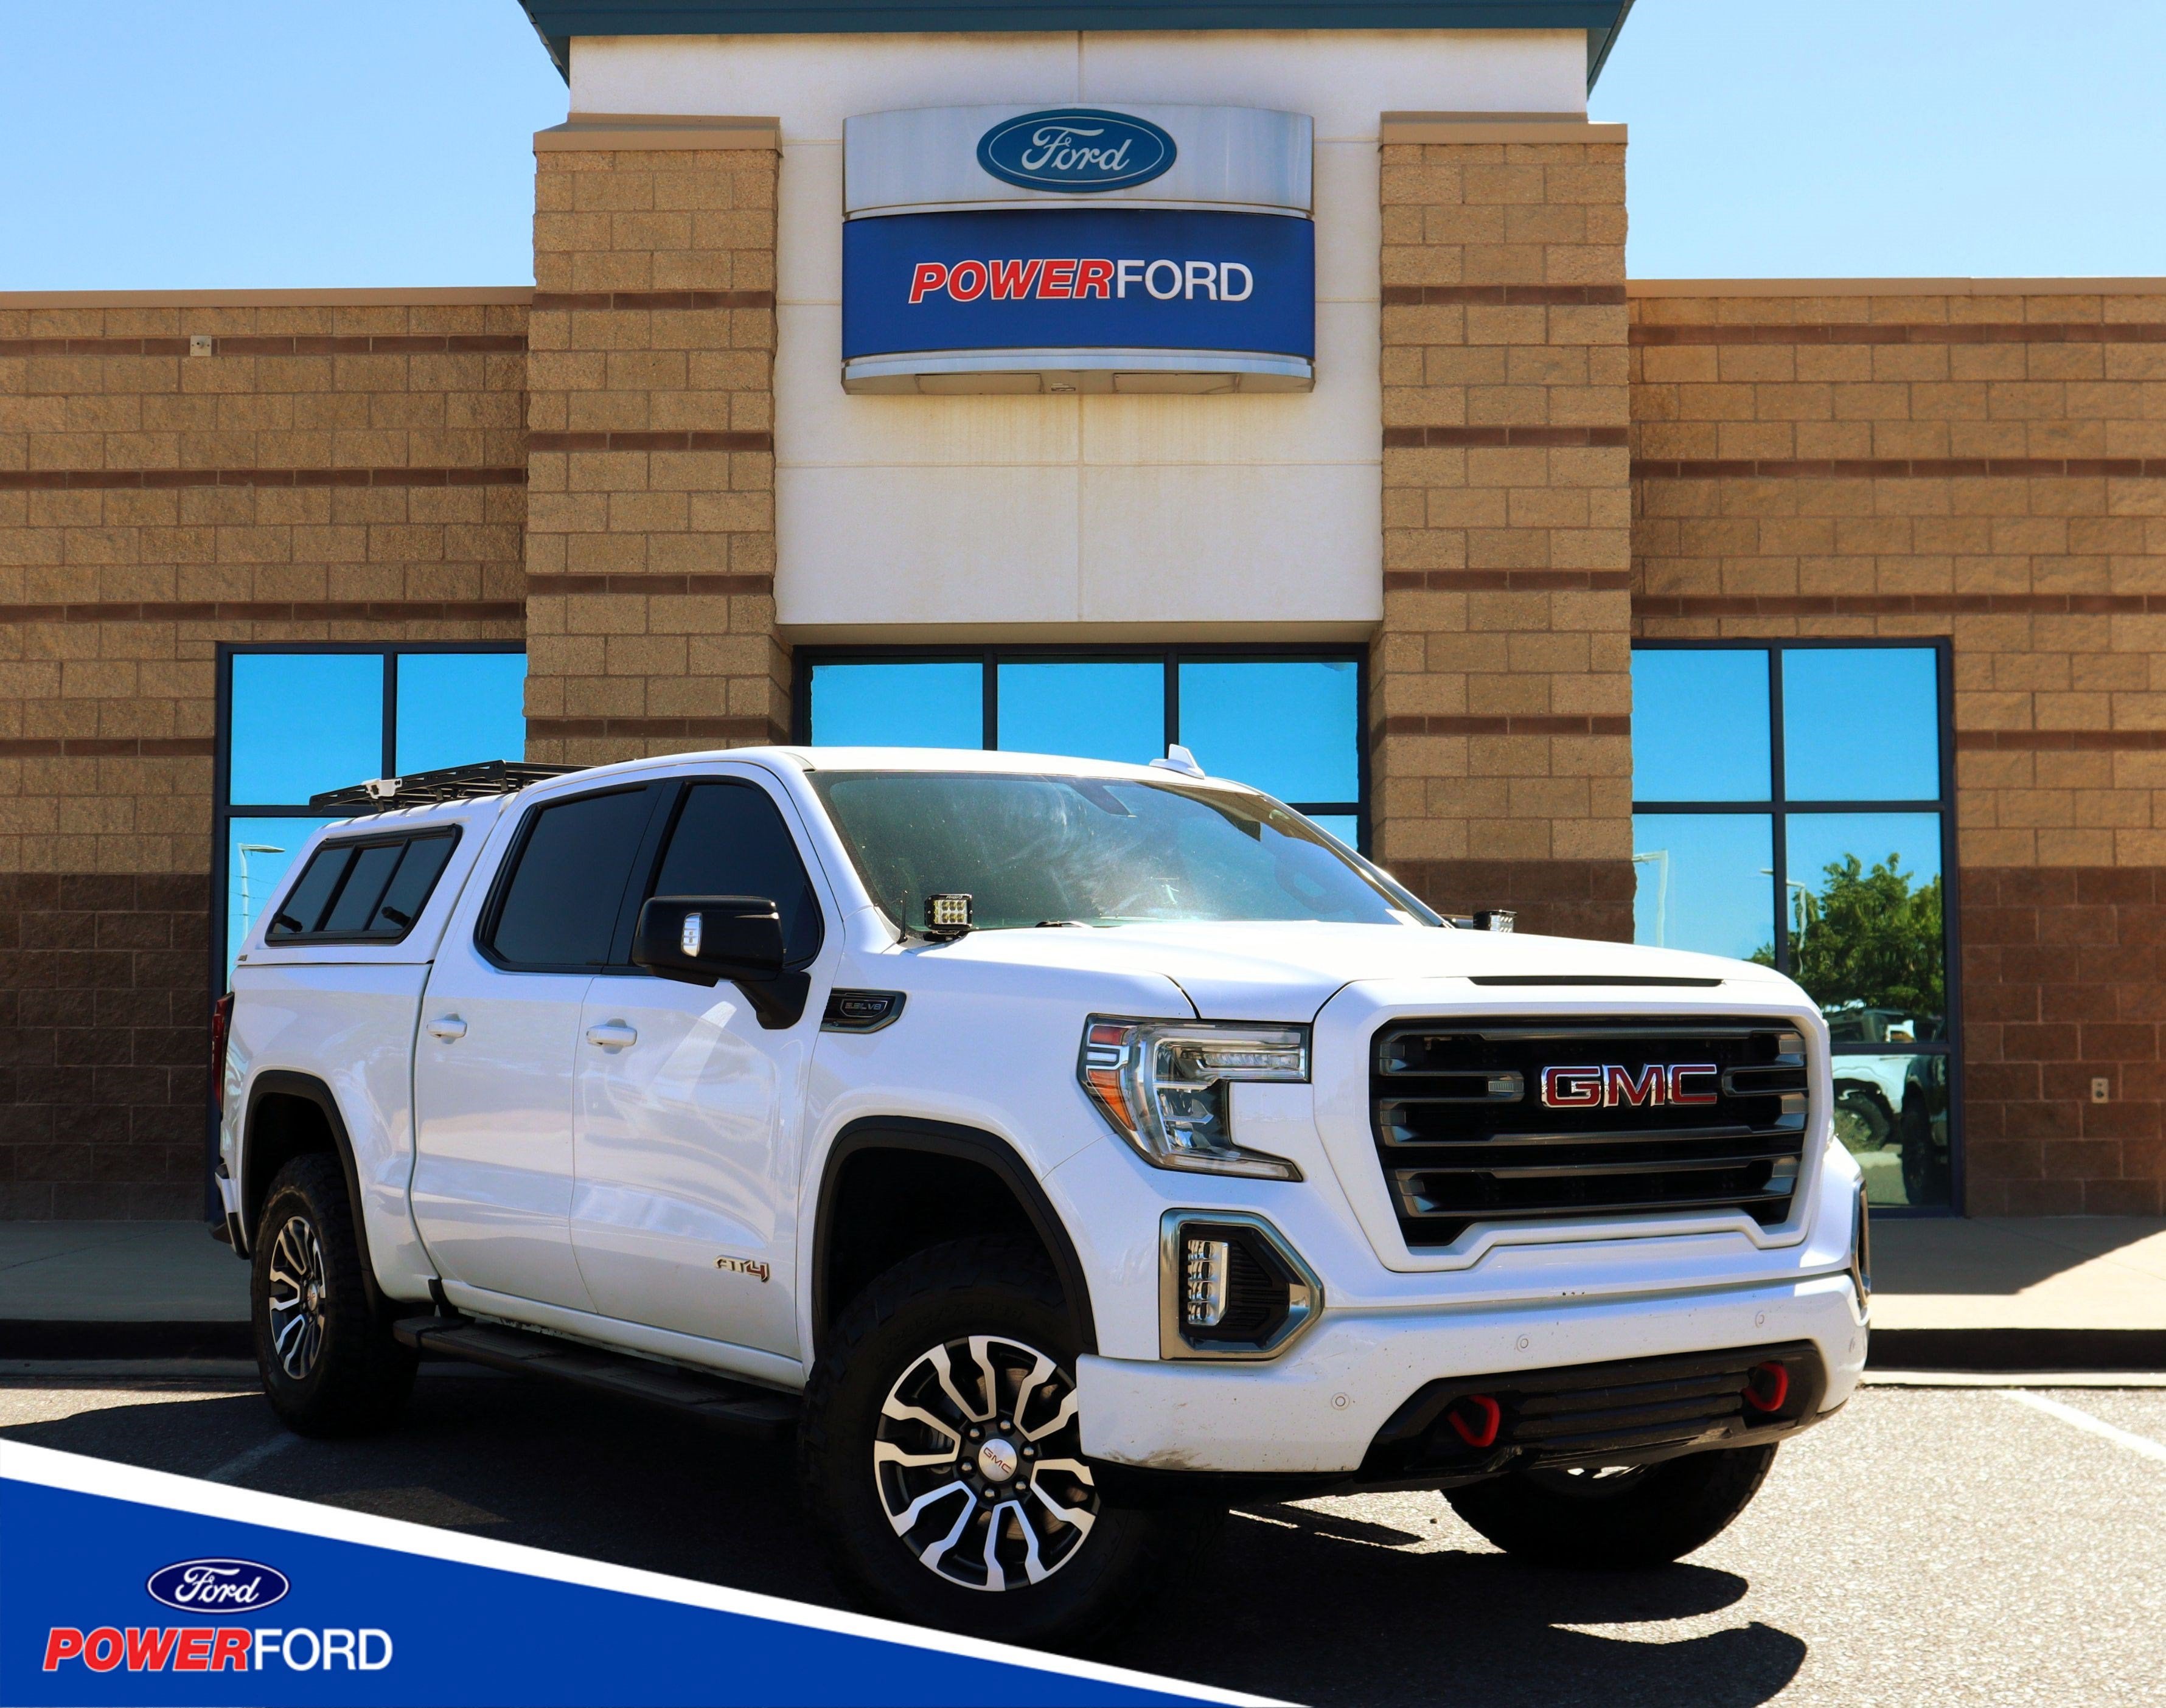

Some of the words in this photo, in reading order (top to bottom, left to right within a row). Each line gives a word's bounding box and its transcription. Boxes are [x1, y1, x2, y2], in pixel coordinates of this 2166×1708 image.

[1022, 126, 1132, 171] Ford
[1541, 1063, 1717, 1107] GMC
[714, 1255, 770, 1283] AT4
[983, 1447, 1012, 1474] GMC
